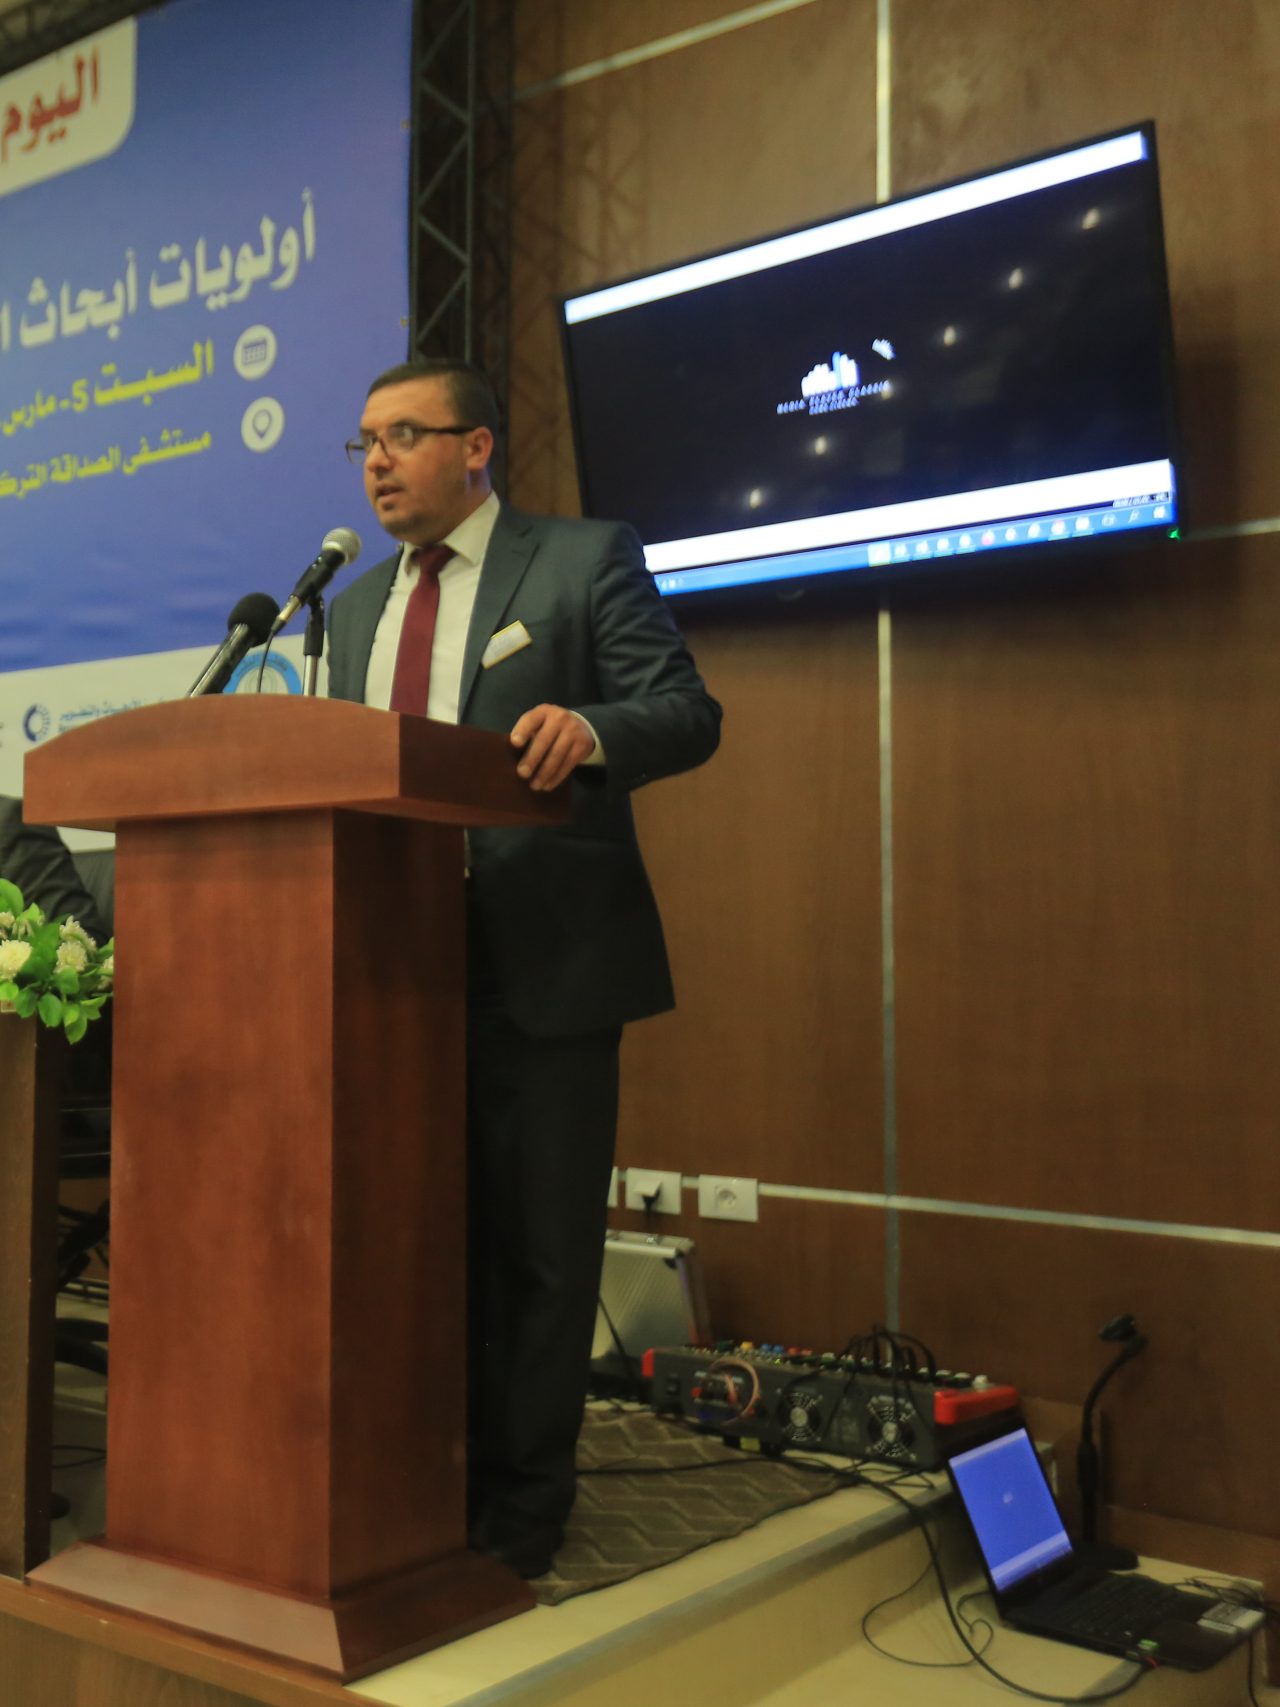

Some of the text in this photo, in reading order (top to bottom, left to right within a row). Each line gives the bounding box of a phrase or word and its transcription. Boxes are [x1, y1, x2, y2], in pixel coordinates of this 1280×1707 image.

[1, 44, 100, 166] اليوم
[149, 186, 317, 312] أولويات
[19, 246, 139, 348] أبحاث
[93, 338, 215, 407] السبت
[50, 446, 122, 484] الصداقة
[122, 427, 212, 476] مستشفى
